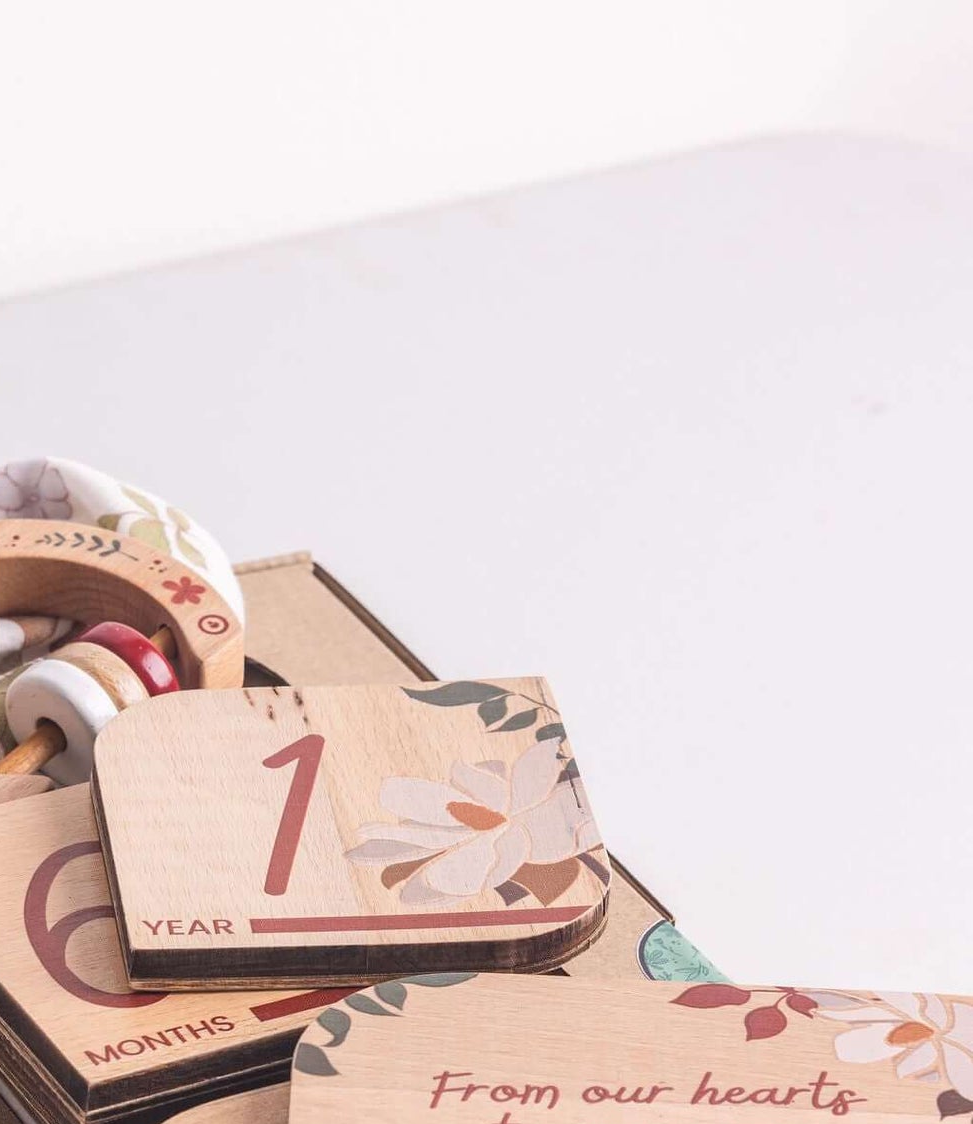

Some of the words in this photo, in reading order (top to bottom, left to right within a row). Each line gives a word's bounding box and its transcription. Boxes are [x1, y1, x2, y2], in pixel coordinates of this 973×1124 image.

[262, 734, 325, 895] 1
[24, 841, 170, 1008] 6
[142, 919, 234, 936] YEAR
[83, 1015, 236, 1066] MONTHS
[429, 1070, 561, 1110] From
[581, 1085, 675, 1105] our
[691, 1071, 868, 1116] hearts
